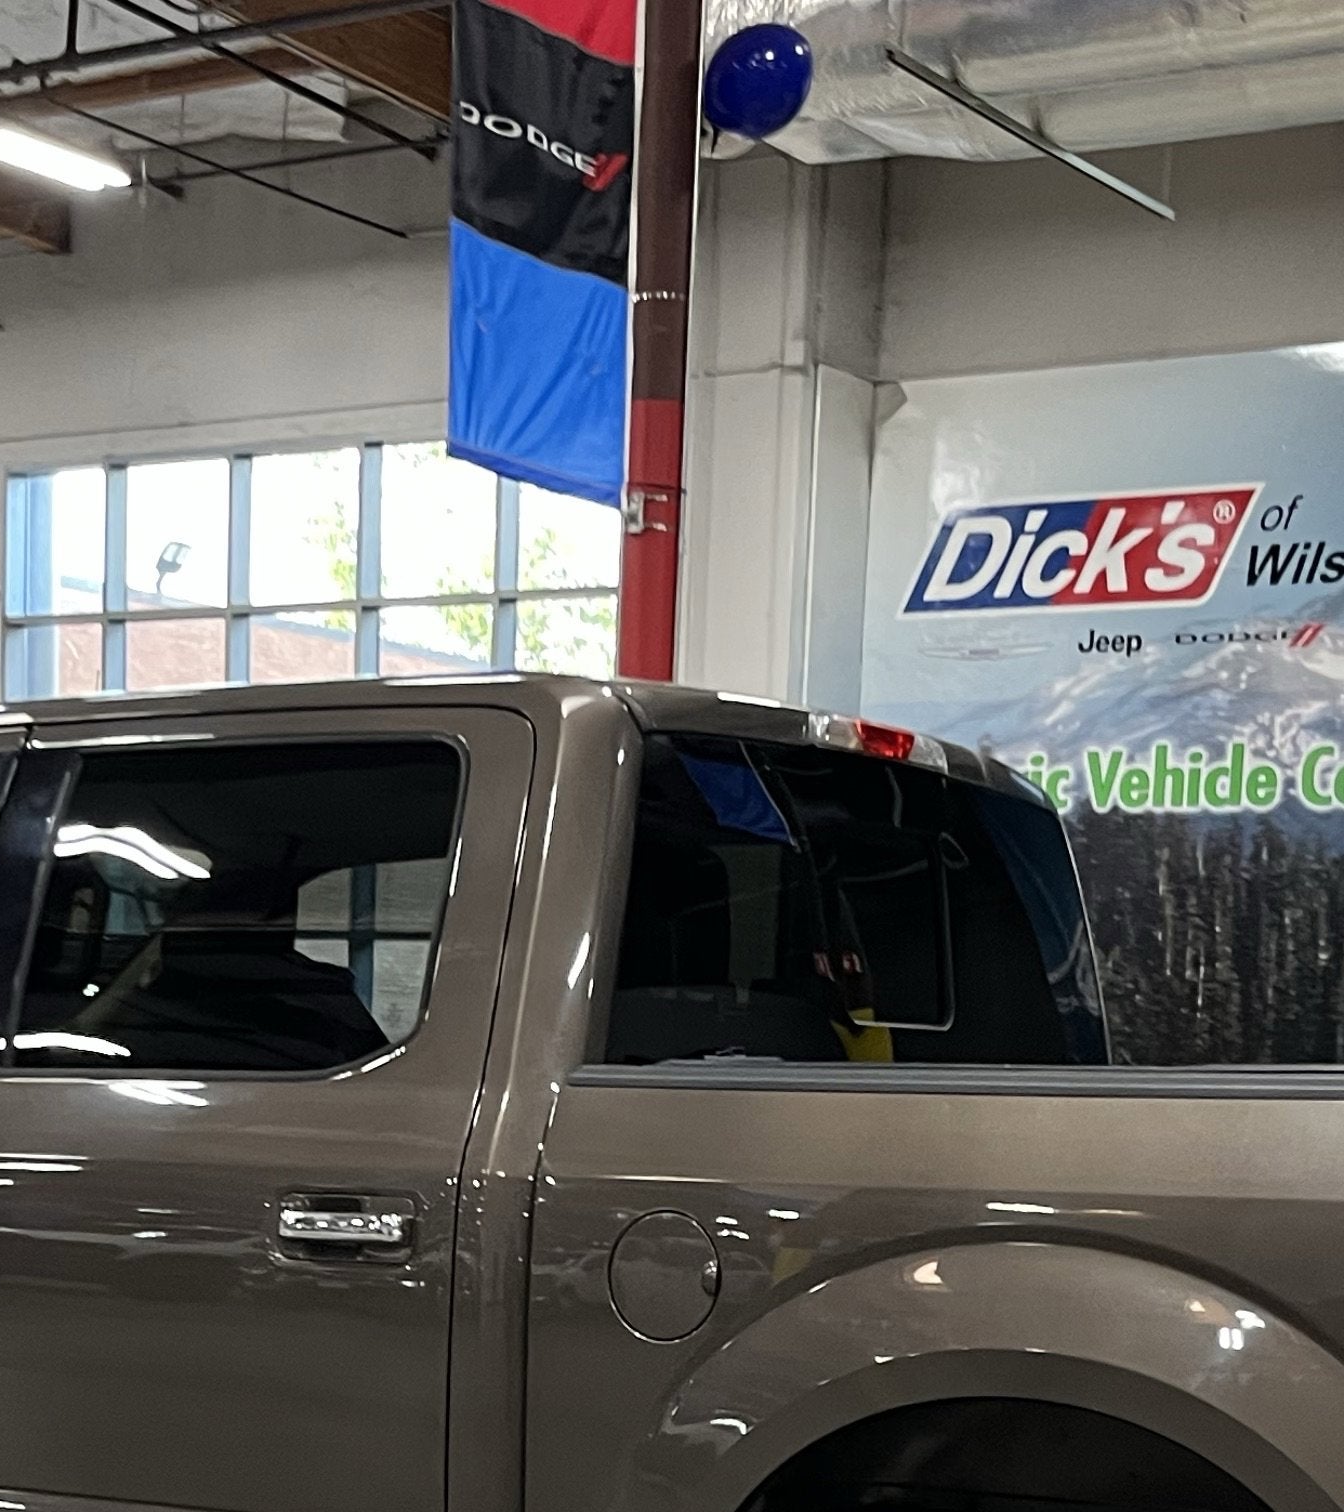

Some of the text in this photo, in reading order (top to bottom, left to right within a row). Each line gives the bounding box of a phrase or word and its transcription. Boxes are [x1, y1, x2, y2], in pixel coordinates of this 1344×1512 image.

[459, 100, 598, 178] DODGE
[1260, 494, 1303, 532] of
[922, 500, 1216, 602] Dick's
[1078, 628, 1143, 657] Jeep
[1024, 754, 1071, 808] ic
[1087, 743, 1278, 808] Vehicle
